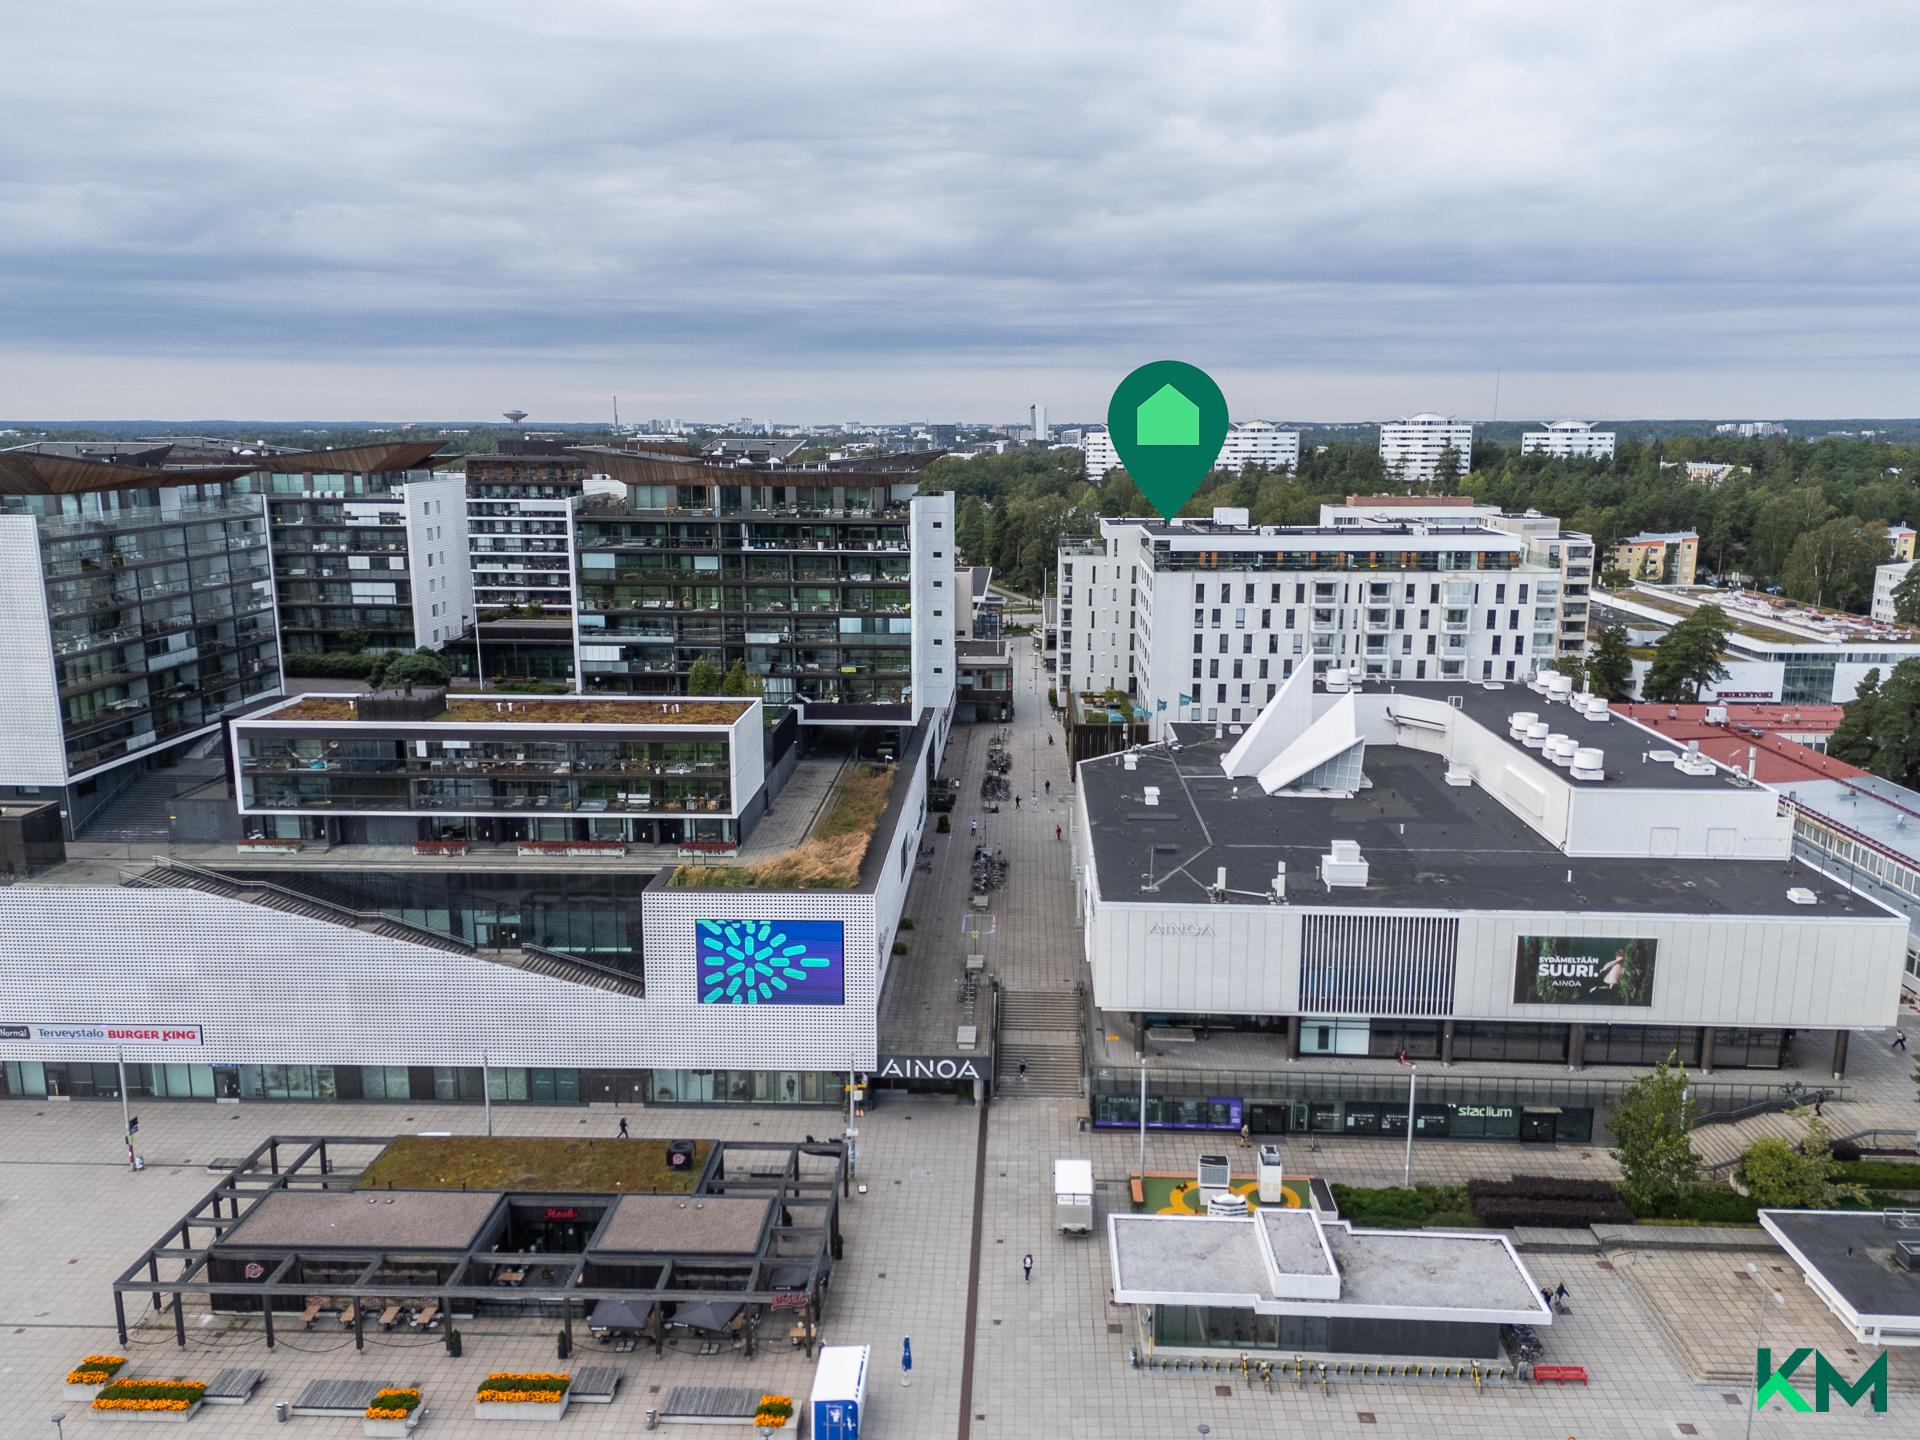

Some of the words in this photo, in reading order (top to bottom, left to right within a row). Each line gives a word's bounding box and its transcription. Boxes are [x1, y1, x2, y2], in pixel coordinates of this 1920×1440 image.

[1147, 921, 1214, 936] AINOA
[1538, 955, 1599, 964] SYDÄMELTÄÄN
[1538, 963, 1599, 978] SUURI.
[0, 1027, 27, 1037] Normal
[38, 1028, 104, 1039] Terveystalo
[108, 1030, 159, 1039] BURGER
[163, 1030, 196, 1041] KING
[880, 1058, 980, 1079] AINOA
[1457, 1105, 1513, 1118] stadium
